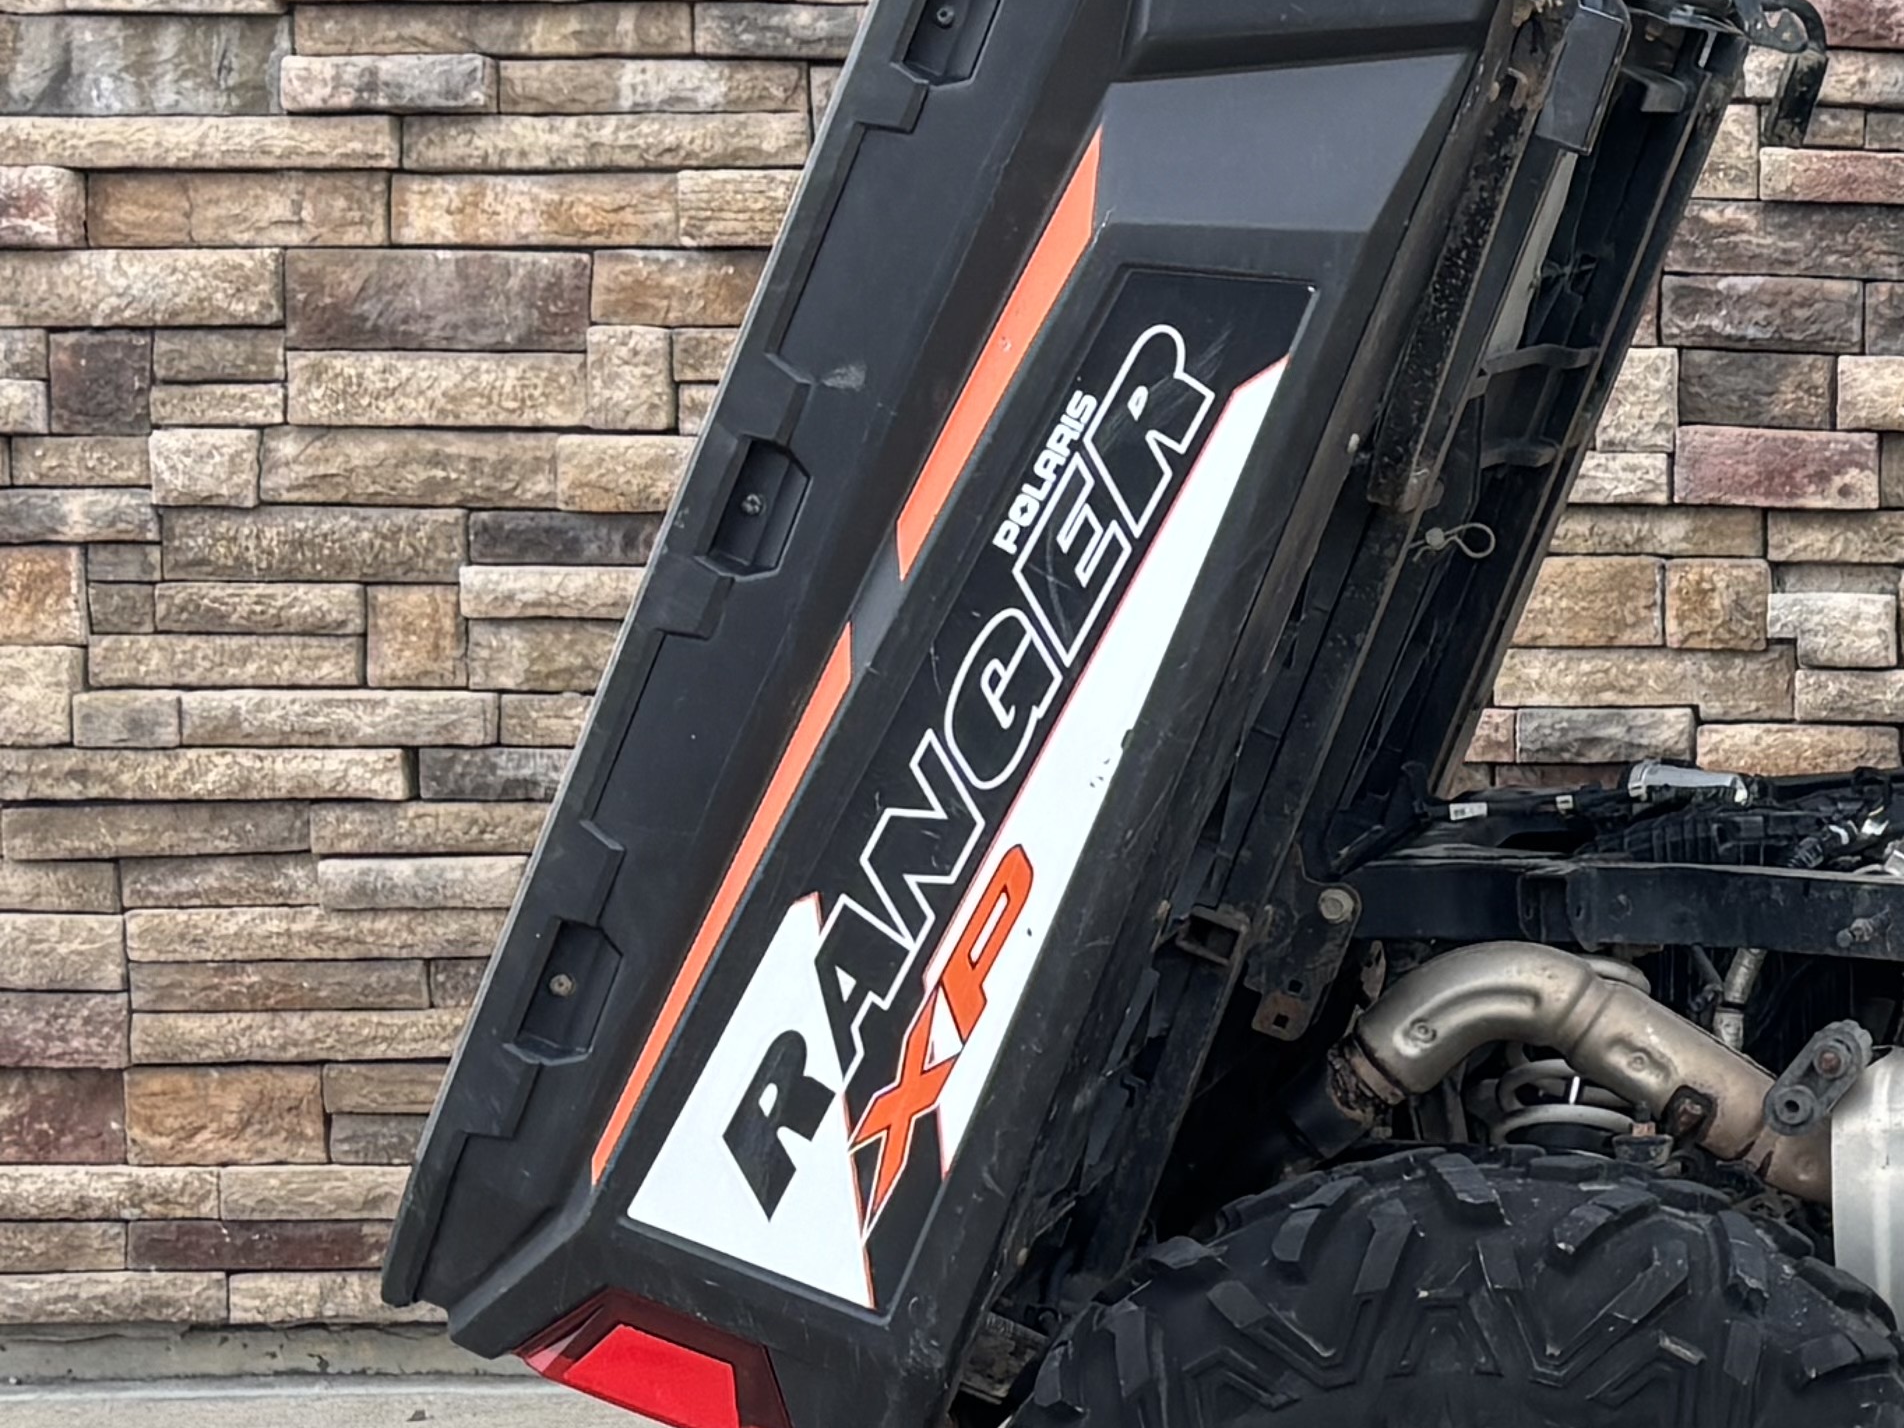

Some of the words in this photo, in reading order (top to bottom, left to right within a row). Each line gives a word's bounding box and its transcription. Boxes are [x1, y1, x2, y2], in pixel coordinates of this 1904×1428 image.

[991, 389, 1099, 555] POLARIS
[721, 323, 1216, 1220] RANGER
[847, 842, 1035, 1236] XP
